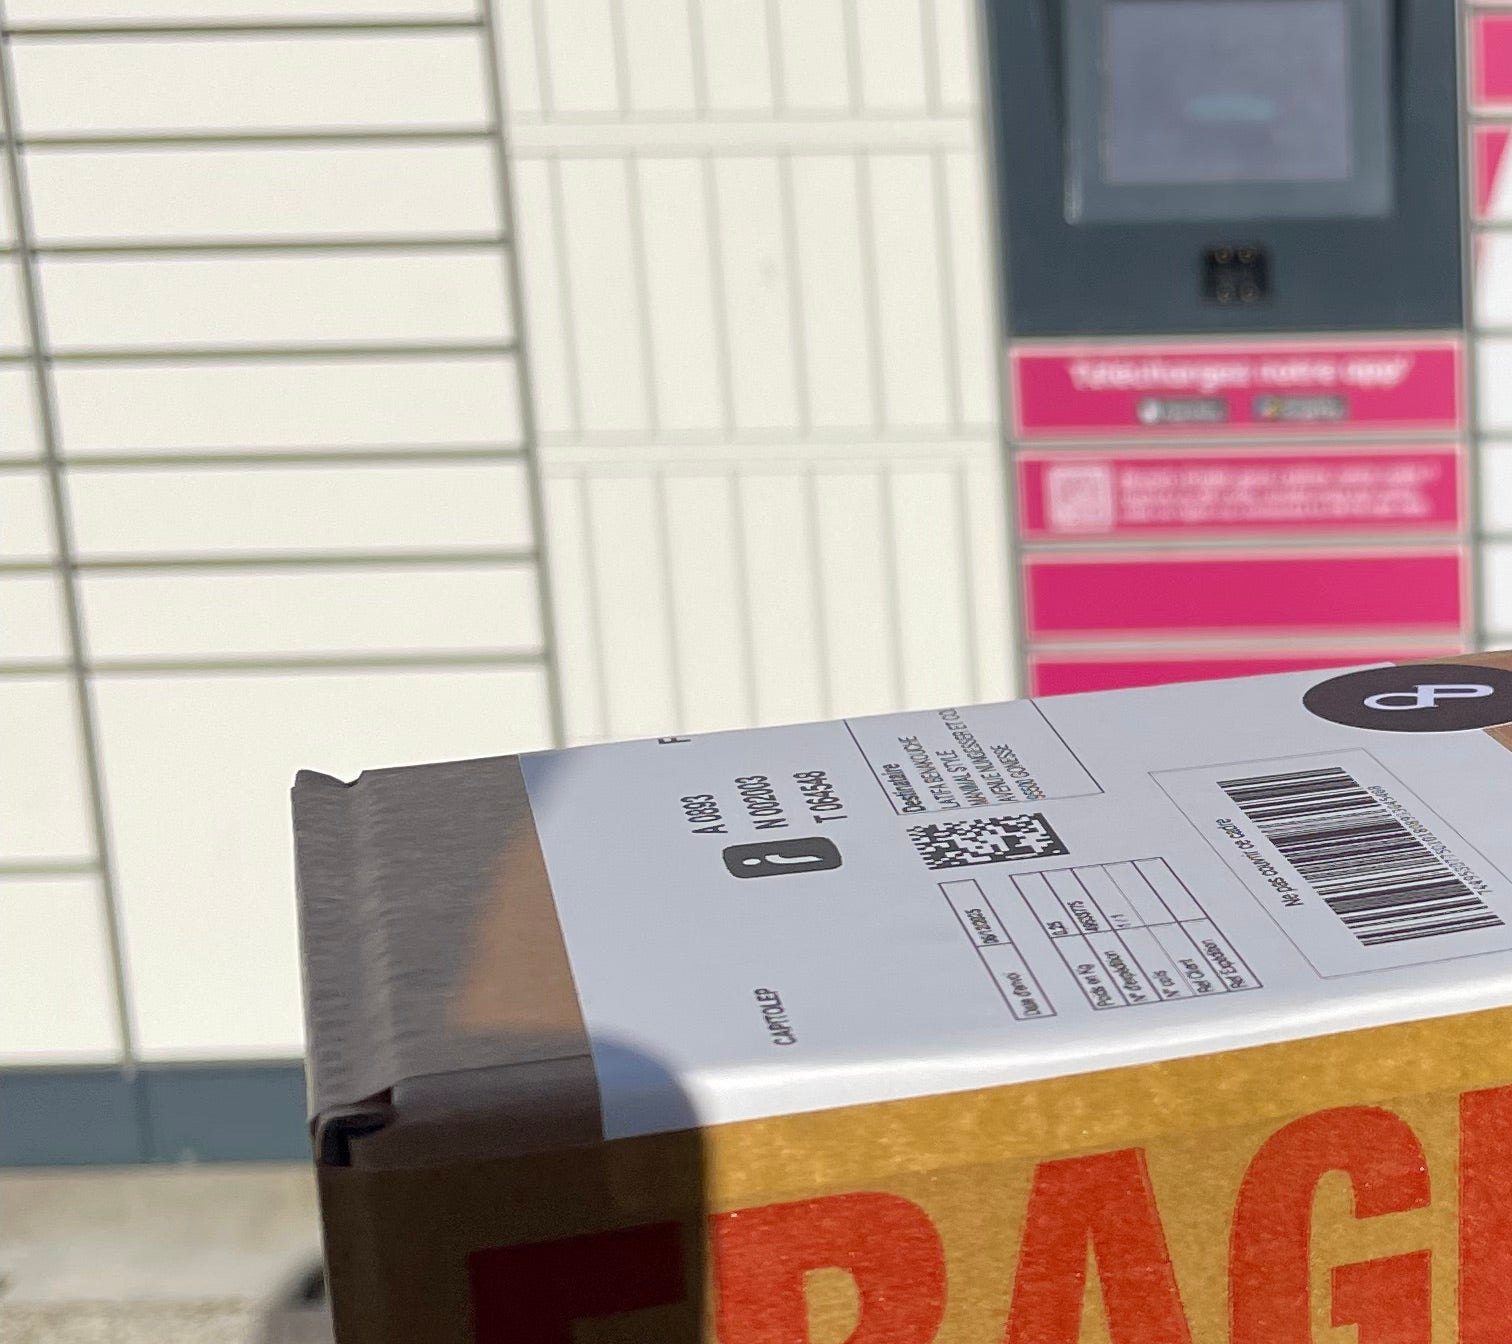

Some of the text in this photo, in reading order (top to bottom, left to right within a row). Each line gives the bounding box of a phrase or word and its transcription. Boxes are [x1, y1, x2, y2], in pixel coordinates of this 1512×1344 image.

[734, 774, 790, 830] N 002003
[793, 770, 848, 824] T 064548
[881, 764, 926, 813] Destinataire
[680, 794, 729, 834] A 0893
[1216, 819, 1245, 838] cadre
[1268, 877, 1297, 892] pas
[1281, 894, 1304, 907] Ne
